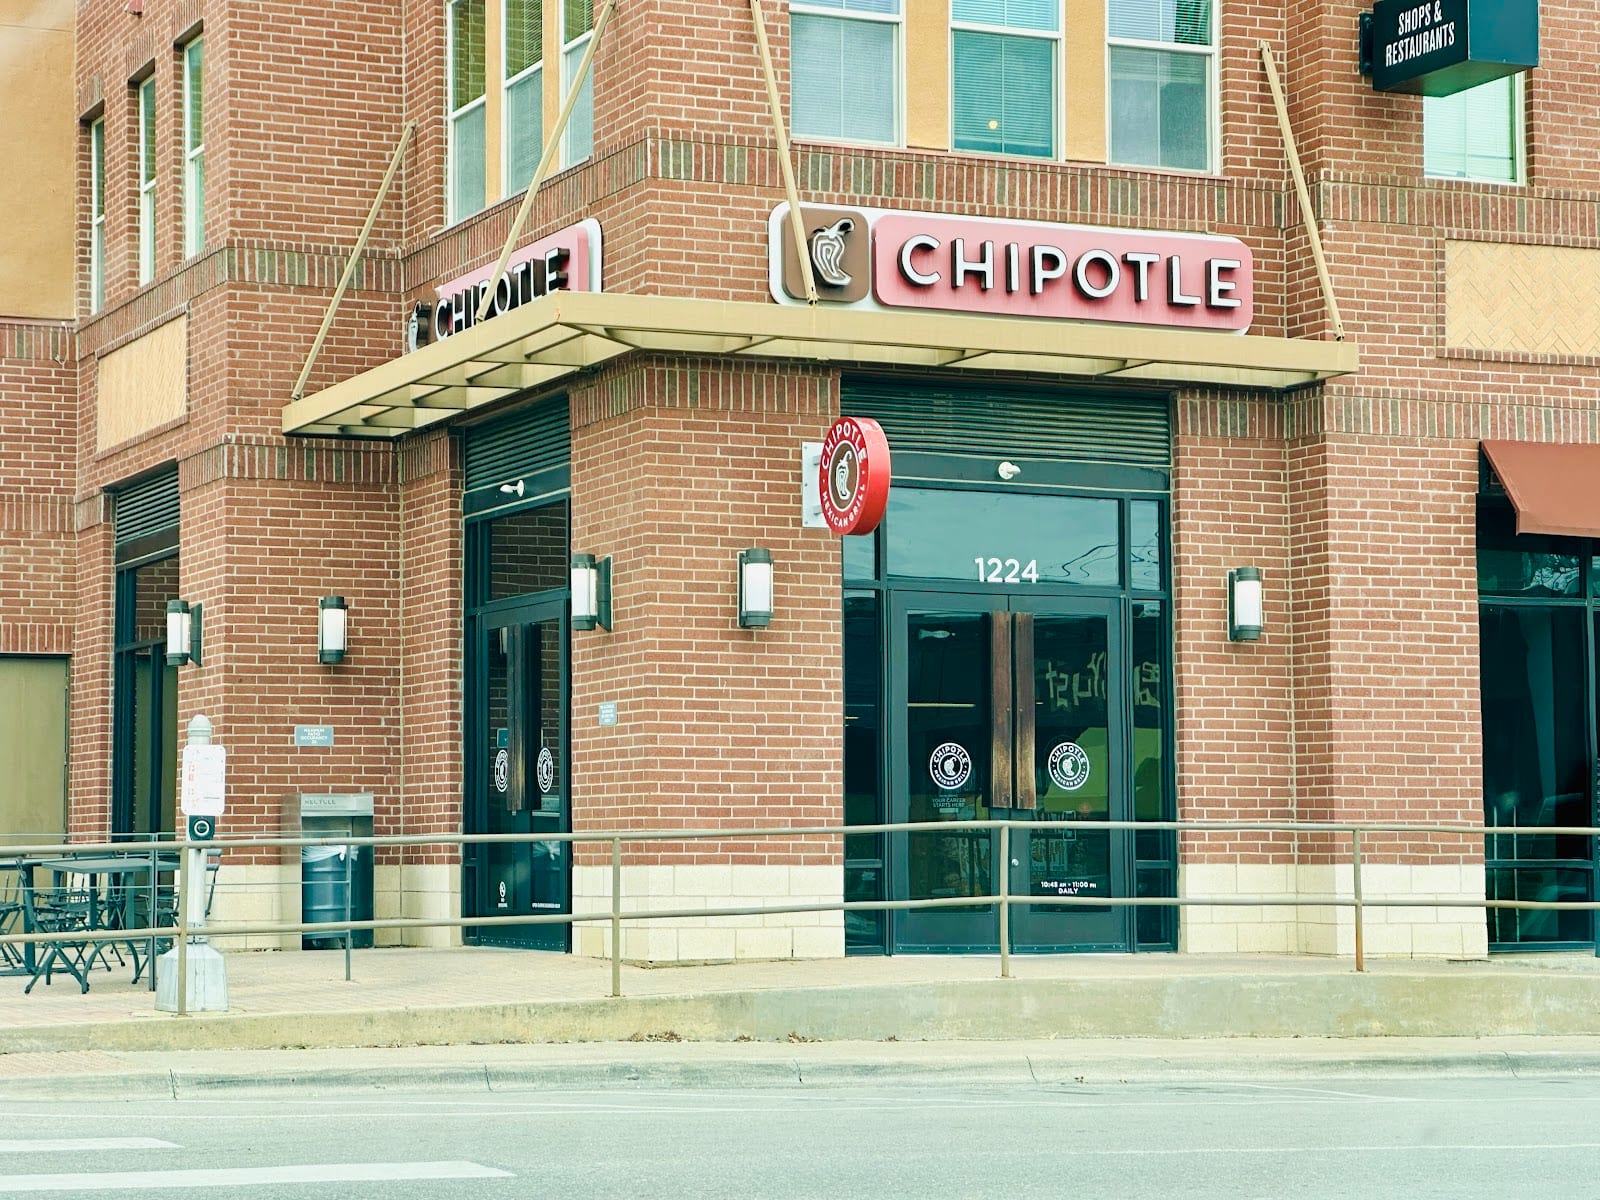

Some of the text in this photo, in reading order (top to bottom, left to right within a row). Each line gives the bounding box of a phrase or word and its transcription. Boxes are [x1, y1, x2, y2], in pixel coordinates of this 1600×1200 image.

[1398, 0, 1443, 36] SHOPS &
[1385, 22, 1455, 67] RESTAURANTS
[899, 233, 1242, 308] CHIPOTLE
[821, 421, 867, 470] CHIPOTLE
[822, 491, 849, 528] MEXICAN
[849, 484, 866, 522] GRILL
[974, 557, 1039, 584] 1224
[933, 746, 968, 764] CHIPOTLE
[1052, 746, 1087, 764] CHIPOTLE
[1072, 880, 1089, 888] 11:00
